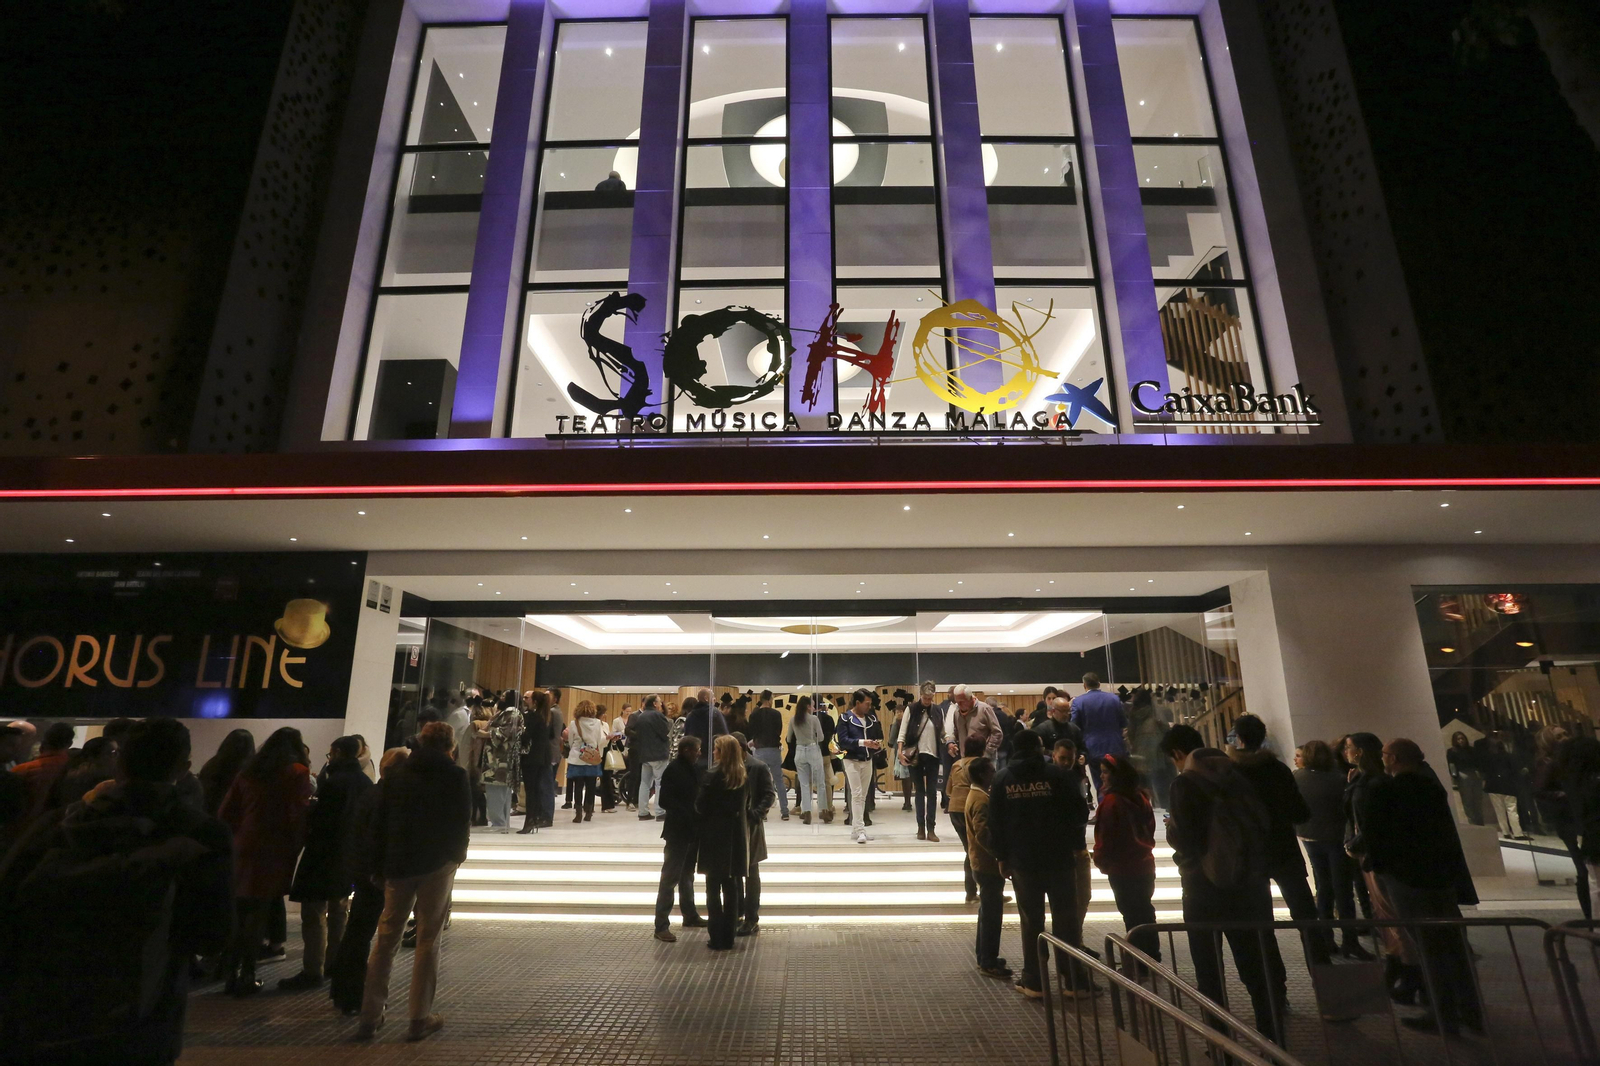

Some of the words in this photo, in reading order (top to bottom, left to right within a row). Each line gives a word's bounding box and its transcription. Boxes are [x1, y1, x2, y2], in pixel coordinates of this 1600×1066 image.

[567, 290, 1058, 415] SOHO
[555, 413, 667, 433] TEATRO
[687, 408, 801, 430] MÚSICA
[827, 411, 931, 430] DANZA
[945, 406, 1073, 430] MÁLAGA
[1130, 380, 1321, 415] CaixaBank
[195, 634, 306, 688] LINE
